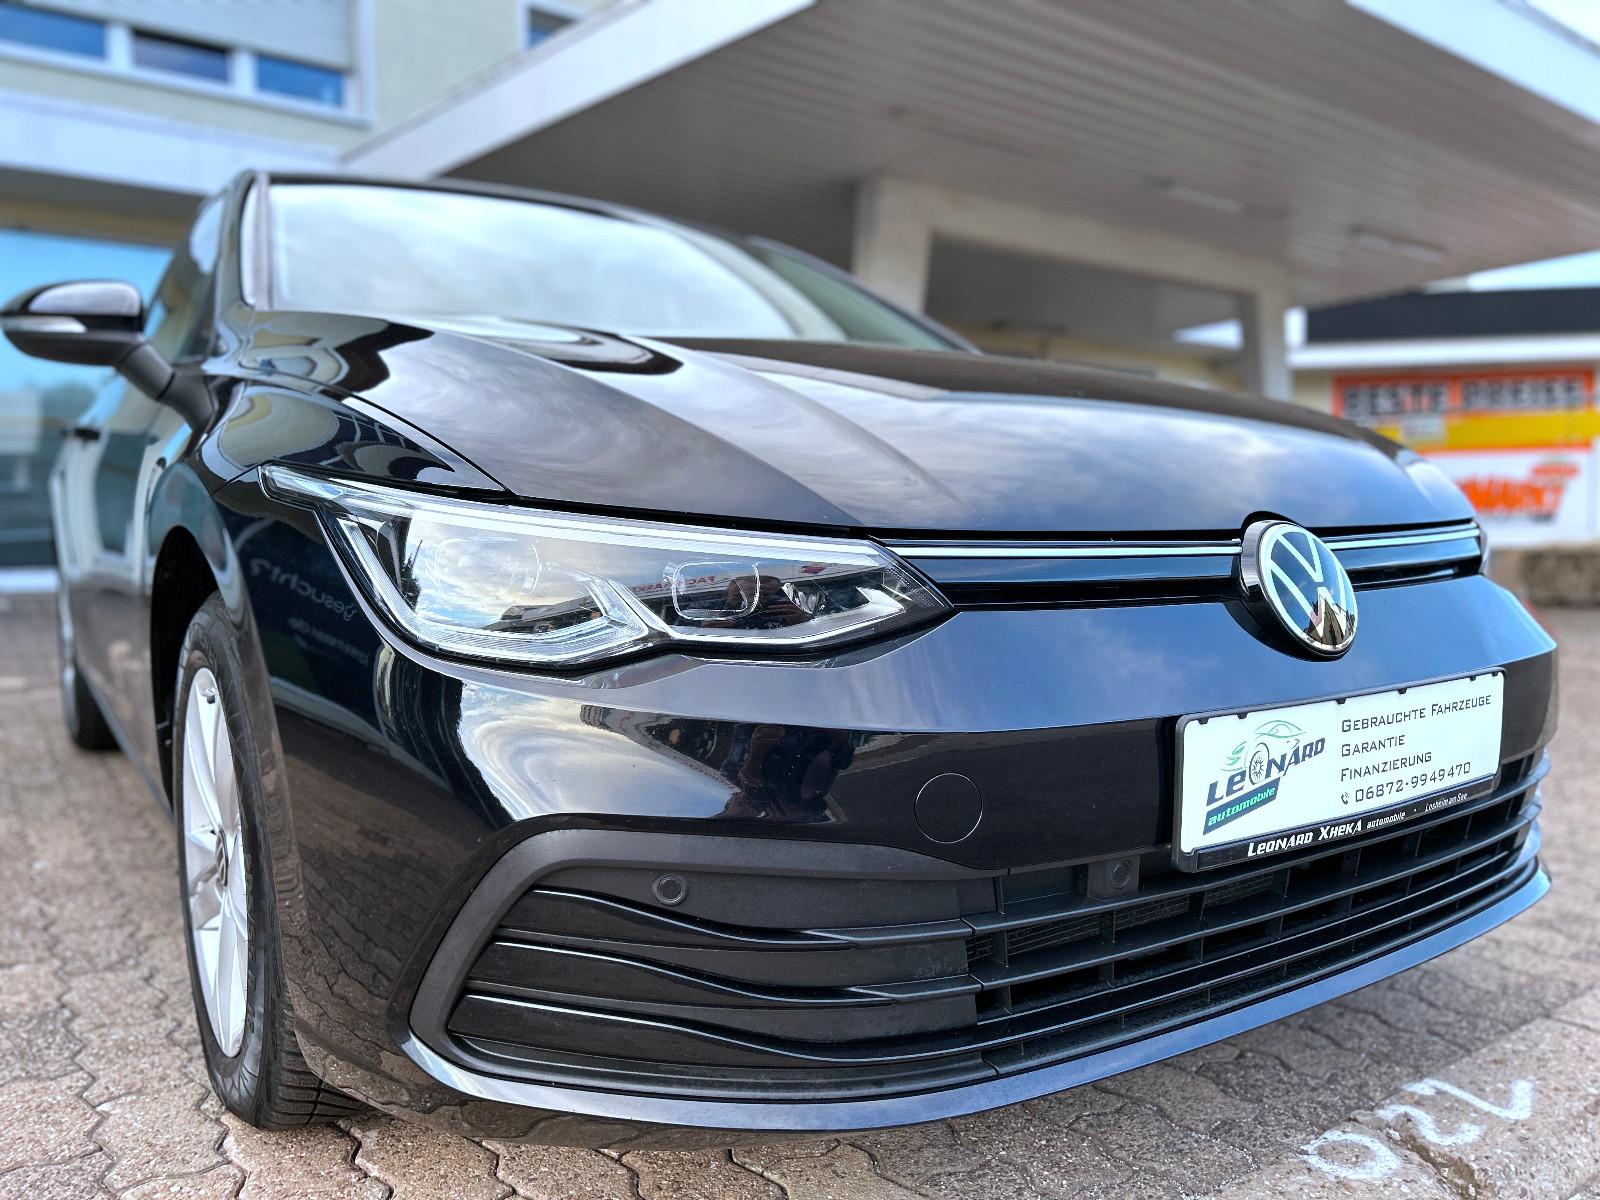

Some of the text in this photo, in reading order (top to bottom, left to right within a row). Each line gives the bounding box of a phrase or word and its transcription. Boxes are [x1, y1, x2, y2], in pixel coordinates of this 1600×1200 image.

[1341, 695, 1492, 733] GEBRAUCHTE FAHRZEUGE
[1341, 734, 1406, 758] GARANTIE
[1340, 752, 1433, 782] FINANZIERUNG
[1207, 787, 1276, 827] automobile
[1366, 811, 1406, 830] automobile
